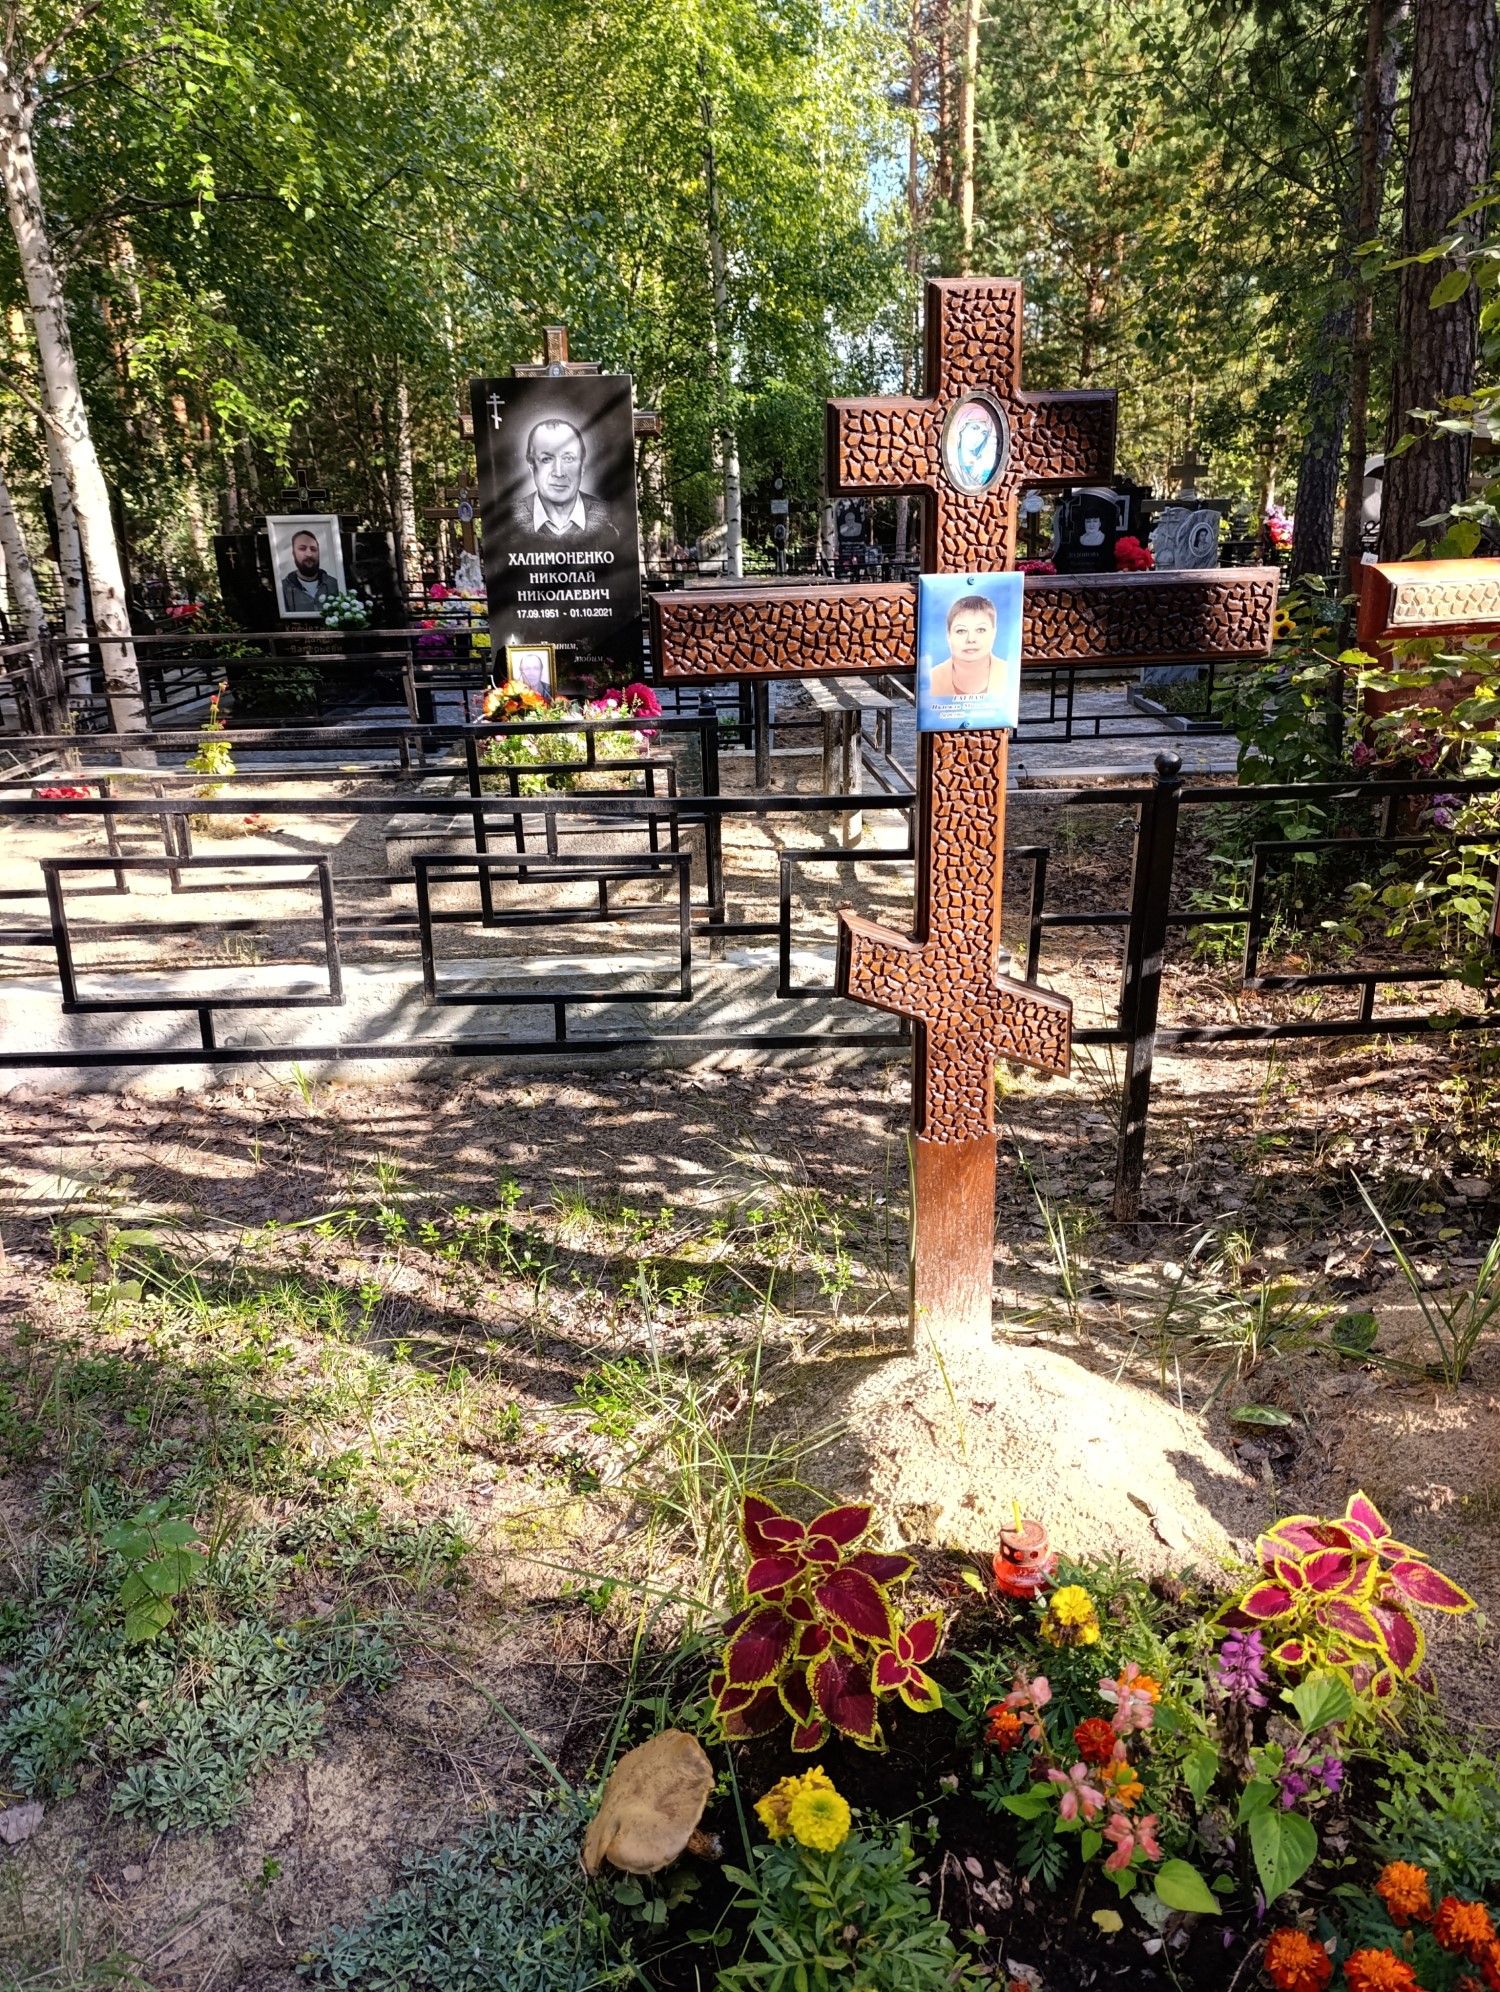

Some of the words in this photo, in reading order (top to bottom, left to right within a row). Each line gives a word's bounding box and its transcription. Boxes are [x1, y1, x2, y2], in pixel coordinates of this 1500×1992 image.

[508, 551, 615, 566] ХАЛИМОНЕНКО
[529, 570, 596, 584] НИКОЛАЙ
[517, 588, 610, 602] НИКОЛАЕВИЧ
[516, 609, 560, 619] 17.09.1951
[569, 608, 613, 618] 01.10.2021
